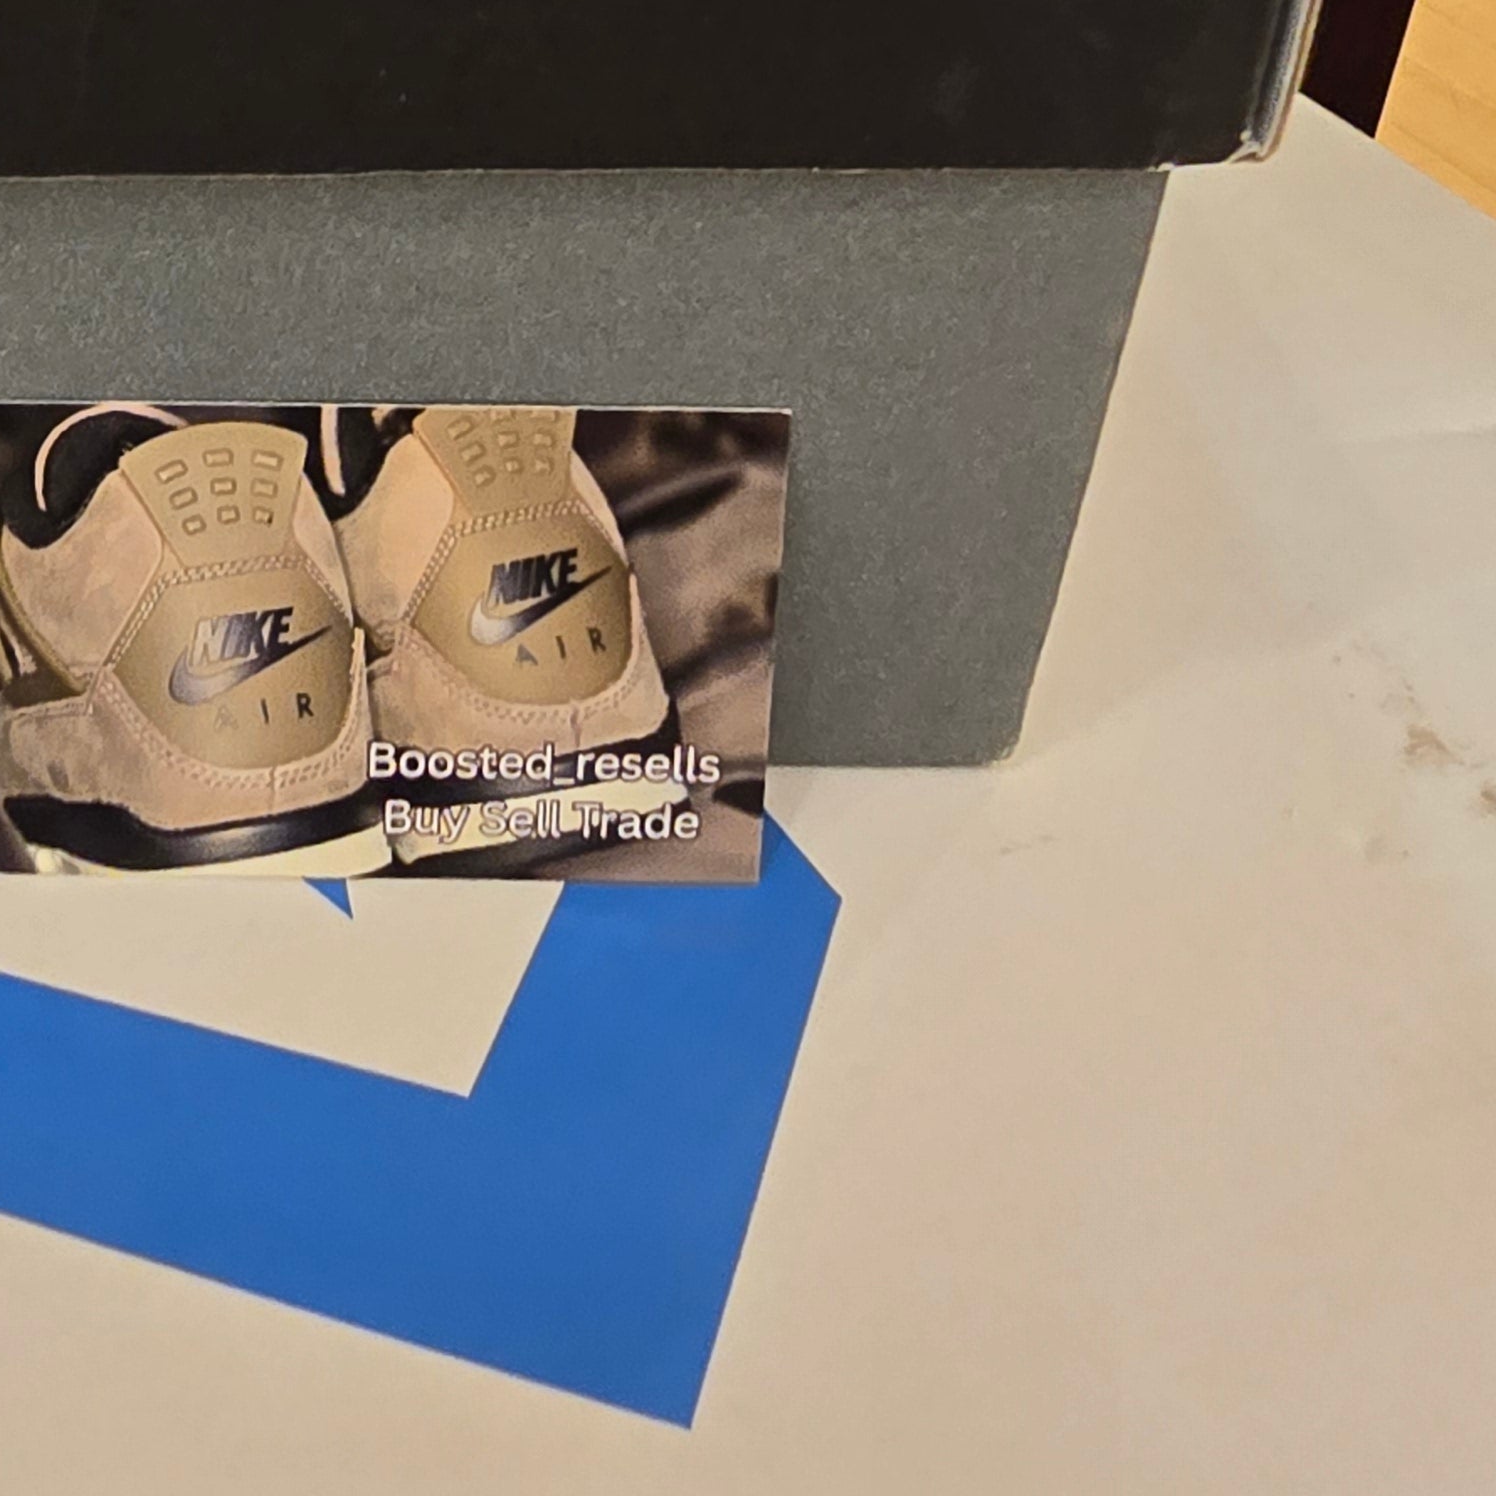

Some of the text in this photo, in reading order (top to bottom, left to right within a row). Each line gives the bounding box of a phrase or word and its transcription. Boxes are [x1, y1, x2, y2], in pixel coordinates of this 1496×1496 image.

[485, 547, 579, 610] NIKE
[189, 605, 295, 666] NIKE
[514, 625, 607, 668] AIR
[368, 741, 721, 785] Boosted_resells
[382, 798, 700, 844] Buy Sell Trade
